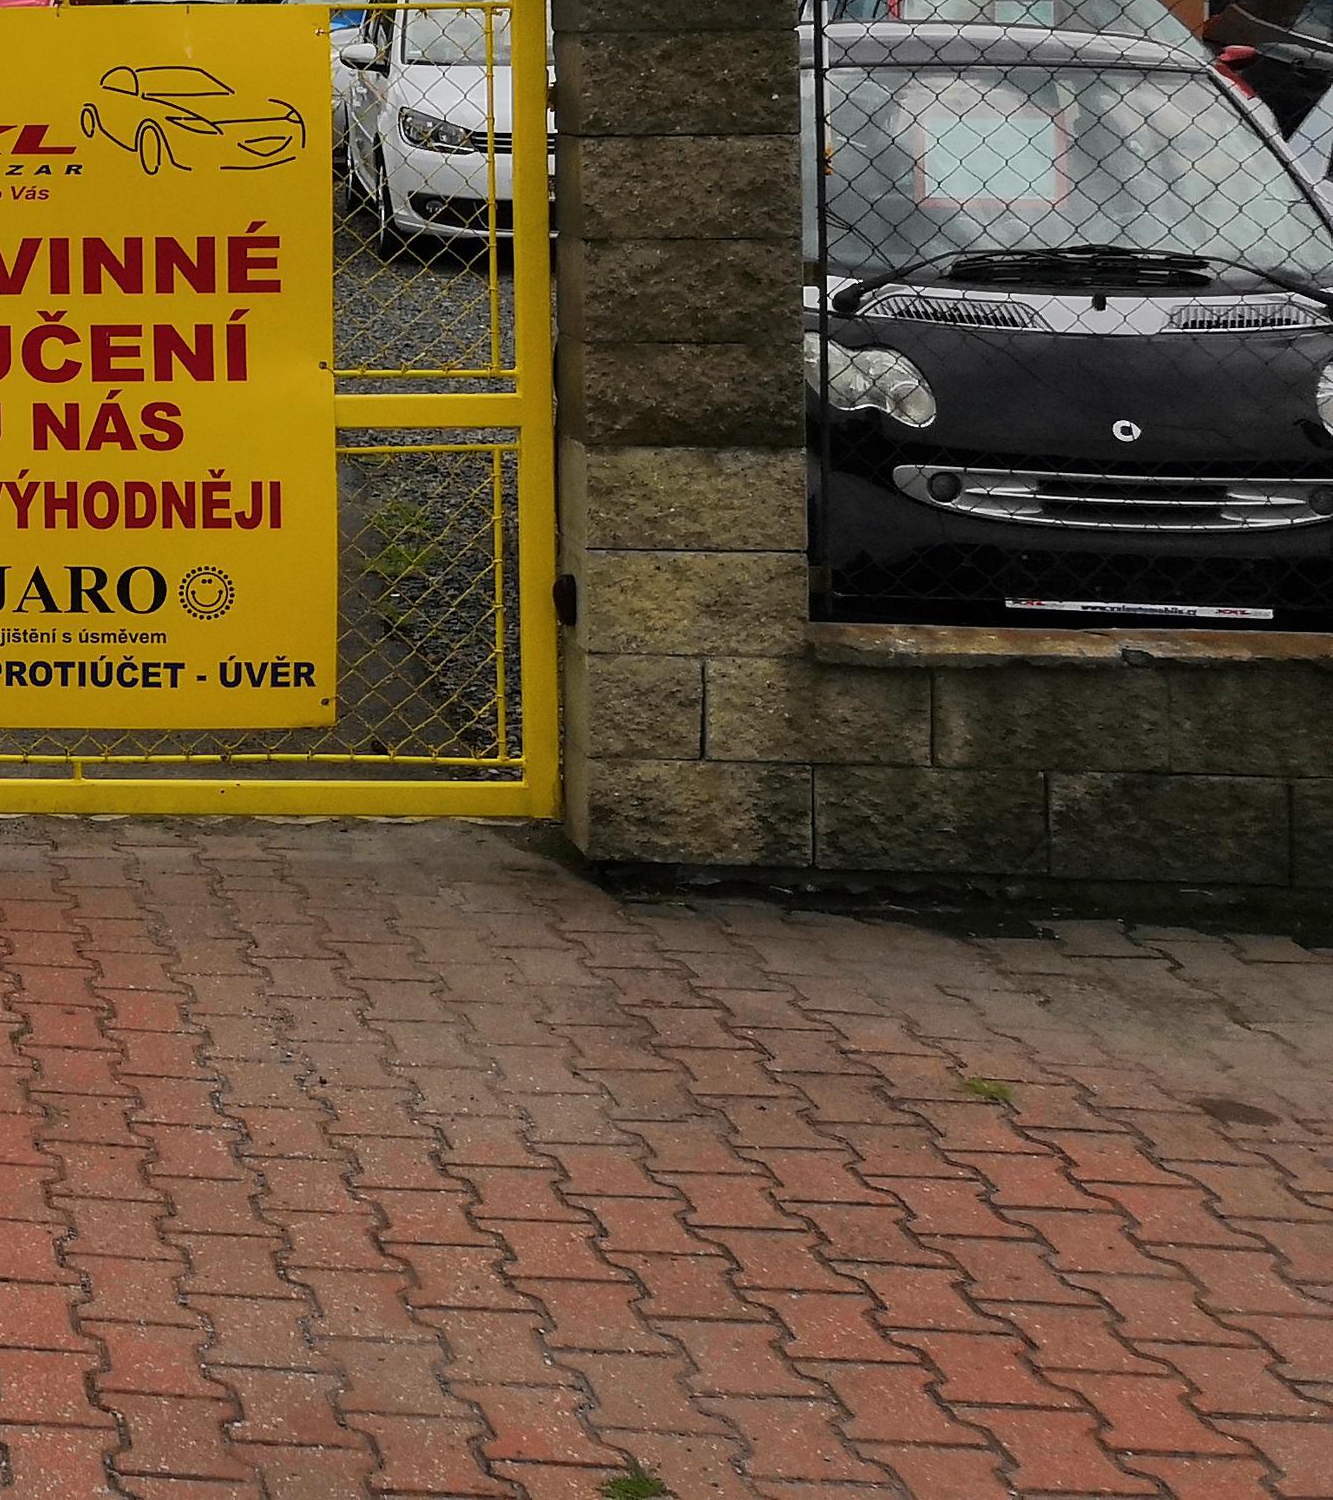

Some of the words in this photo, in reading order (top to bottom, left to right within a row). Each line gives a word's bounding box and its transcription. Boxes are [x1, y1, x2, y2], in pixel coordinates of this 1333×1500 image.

[10, 185, 50, 201] Vás
[33, 390, 185, 451] NÁS
[62, 633, 71, 644] s
[78, 628, 168, 644] úsměvem
[219, 655, 317, 689] ÚVĚR
